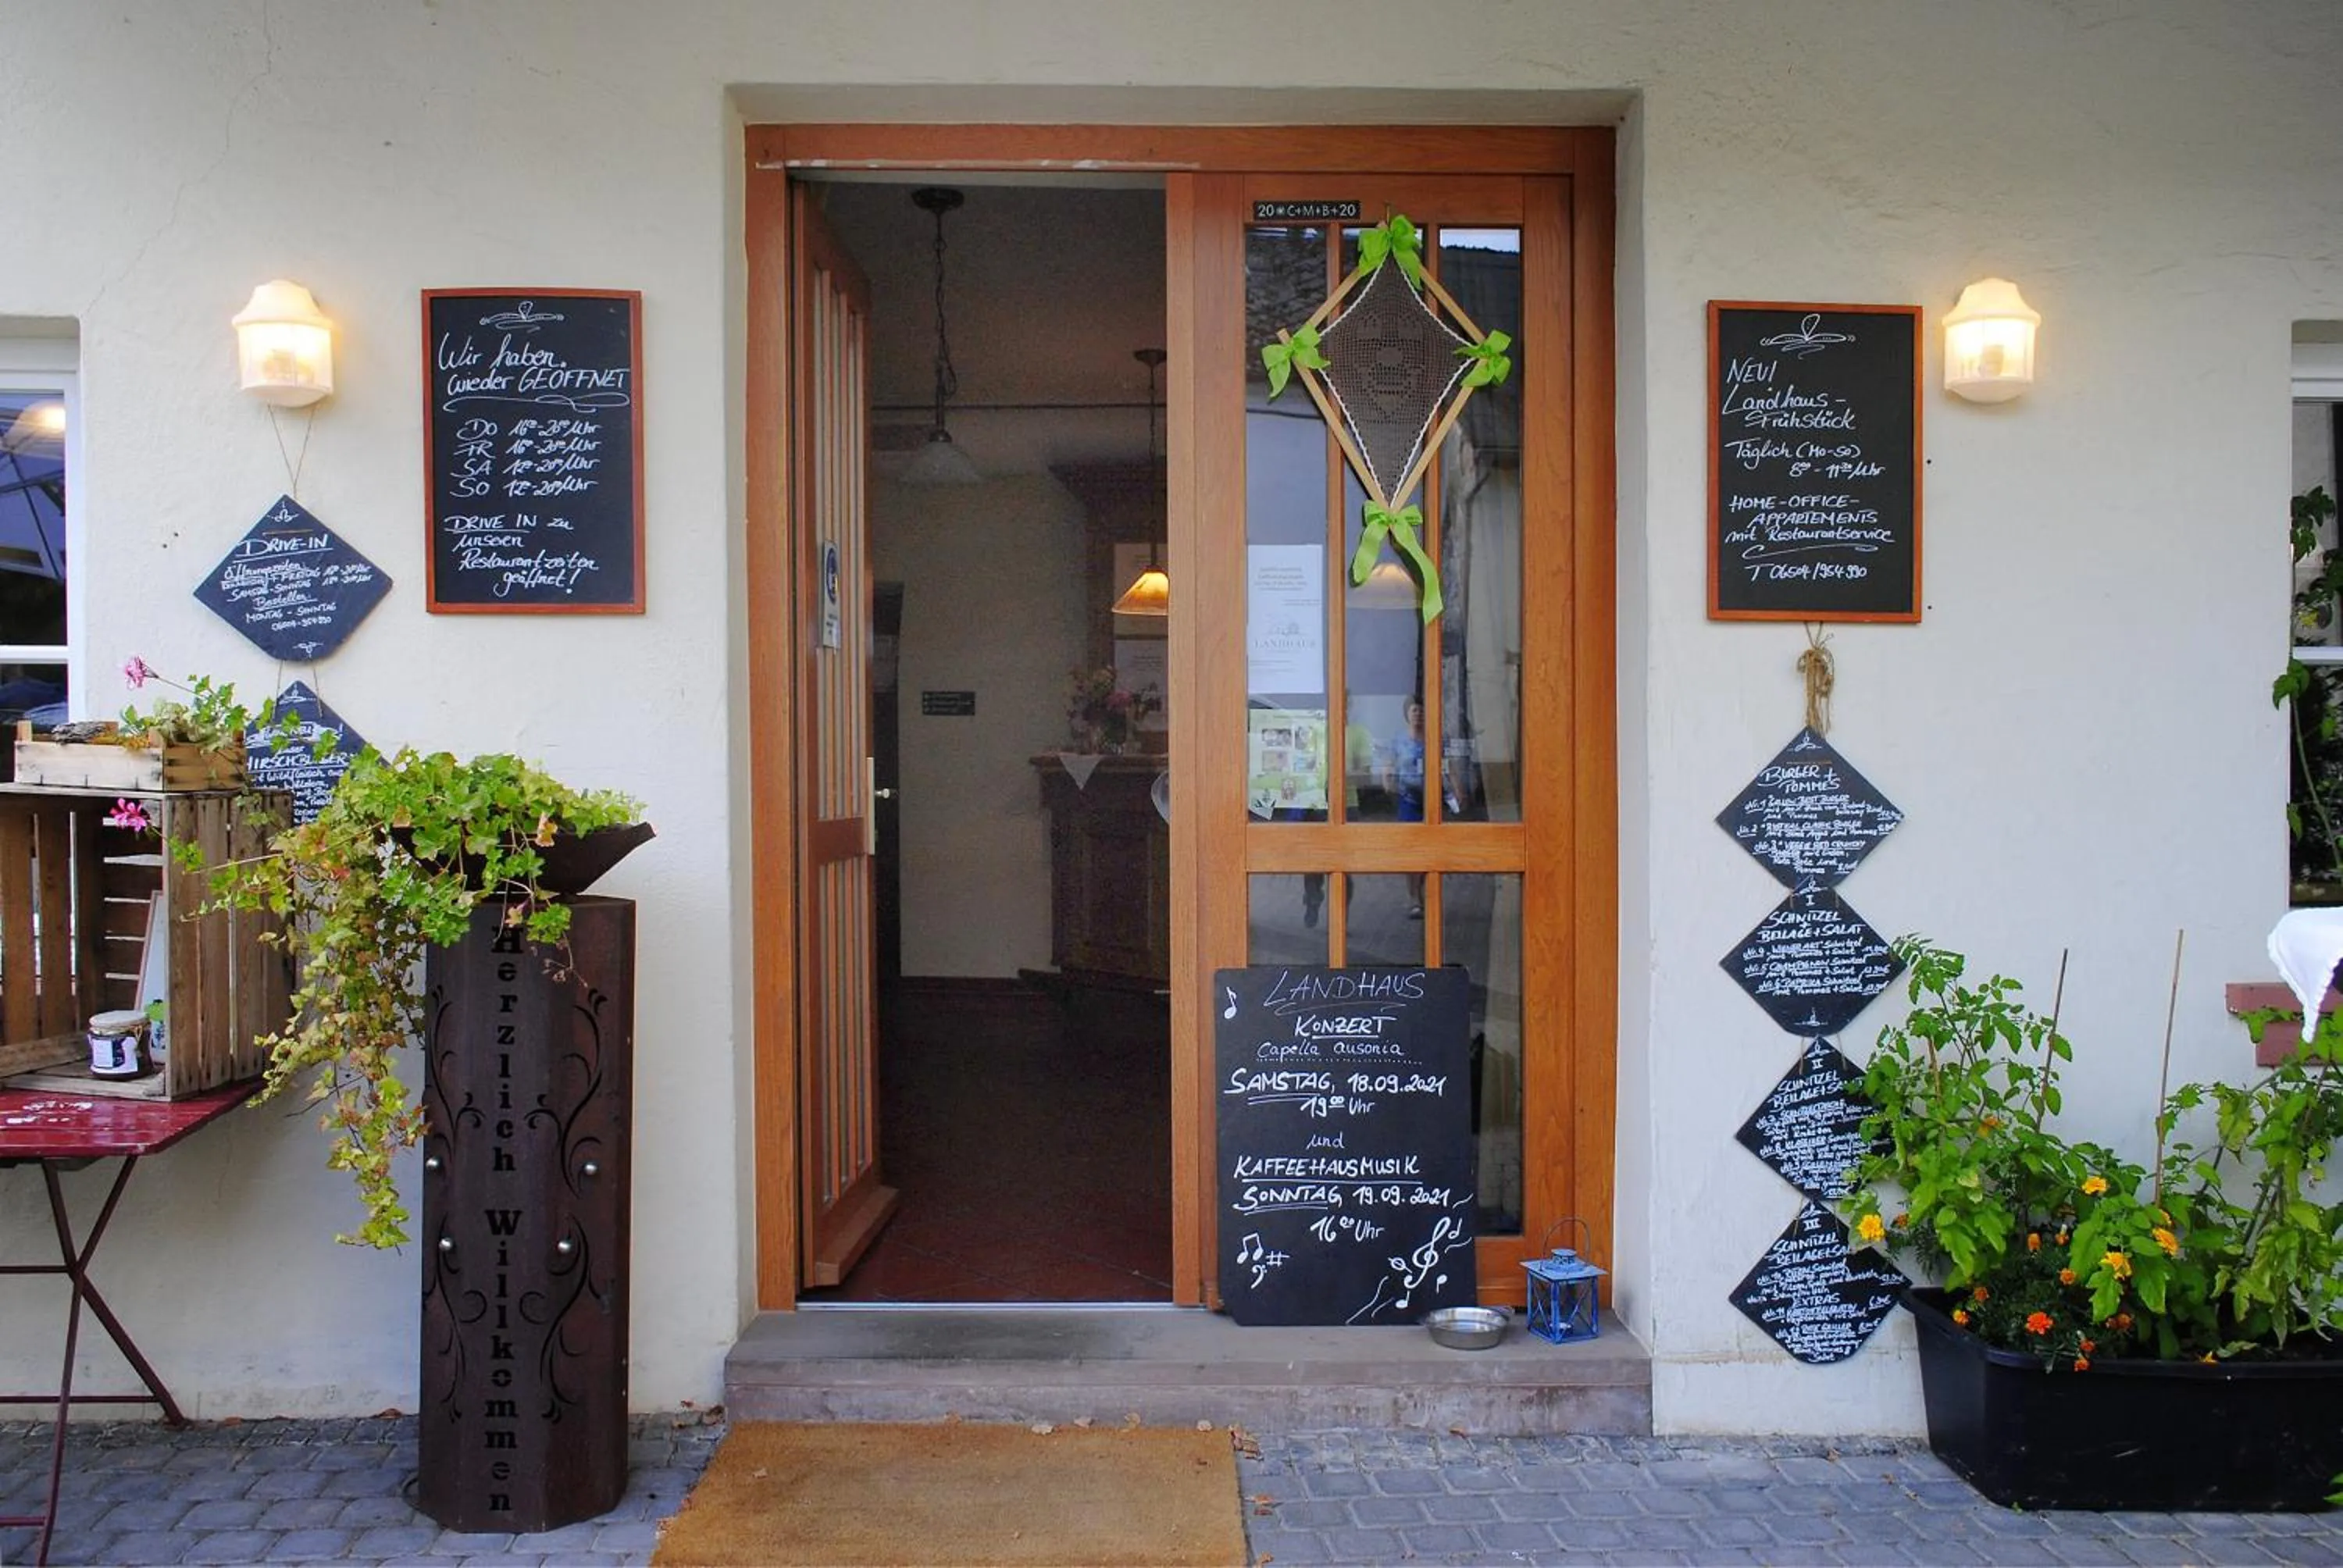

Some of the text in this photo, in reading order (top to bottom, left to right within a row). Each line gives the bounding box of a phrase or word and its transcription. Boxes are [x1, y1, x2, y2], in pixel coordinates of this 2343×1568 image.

[439, 332, 482, 369] Wir
[448, 370, 514, 396] wieder
[1745, 408, 1856, 430] Frühstück
[1724, 437, 1793, 469] Täglich
[444, 515, 505, 531] DRIVE
[516, 513, 537, 527] IN
[1724, 526, 1757, 543] mit
[1744, 563, 1774, 581] T
[1757, 765, 1821, 786] BURGER
[1762, 911, 1842, 928] SCHNITZEL
[1821, 924, 1866, 935] SALAT
[1263, 969, 1426, 1007] LANDHAUS
[1257, 1039, 1320, 1065] Capella
[1349, 1096, 1376, 1115] Uhr
[1306, 1131, 1345, 1150] und
[1234, 1155, 1420, 1179] KAFFEEHAUSMUSIK
[1355, 1217, 1385, 1241] Uhr
[1792, 1293, 1841, 1307] EXTRAS
